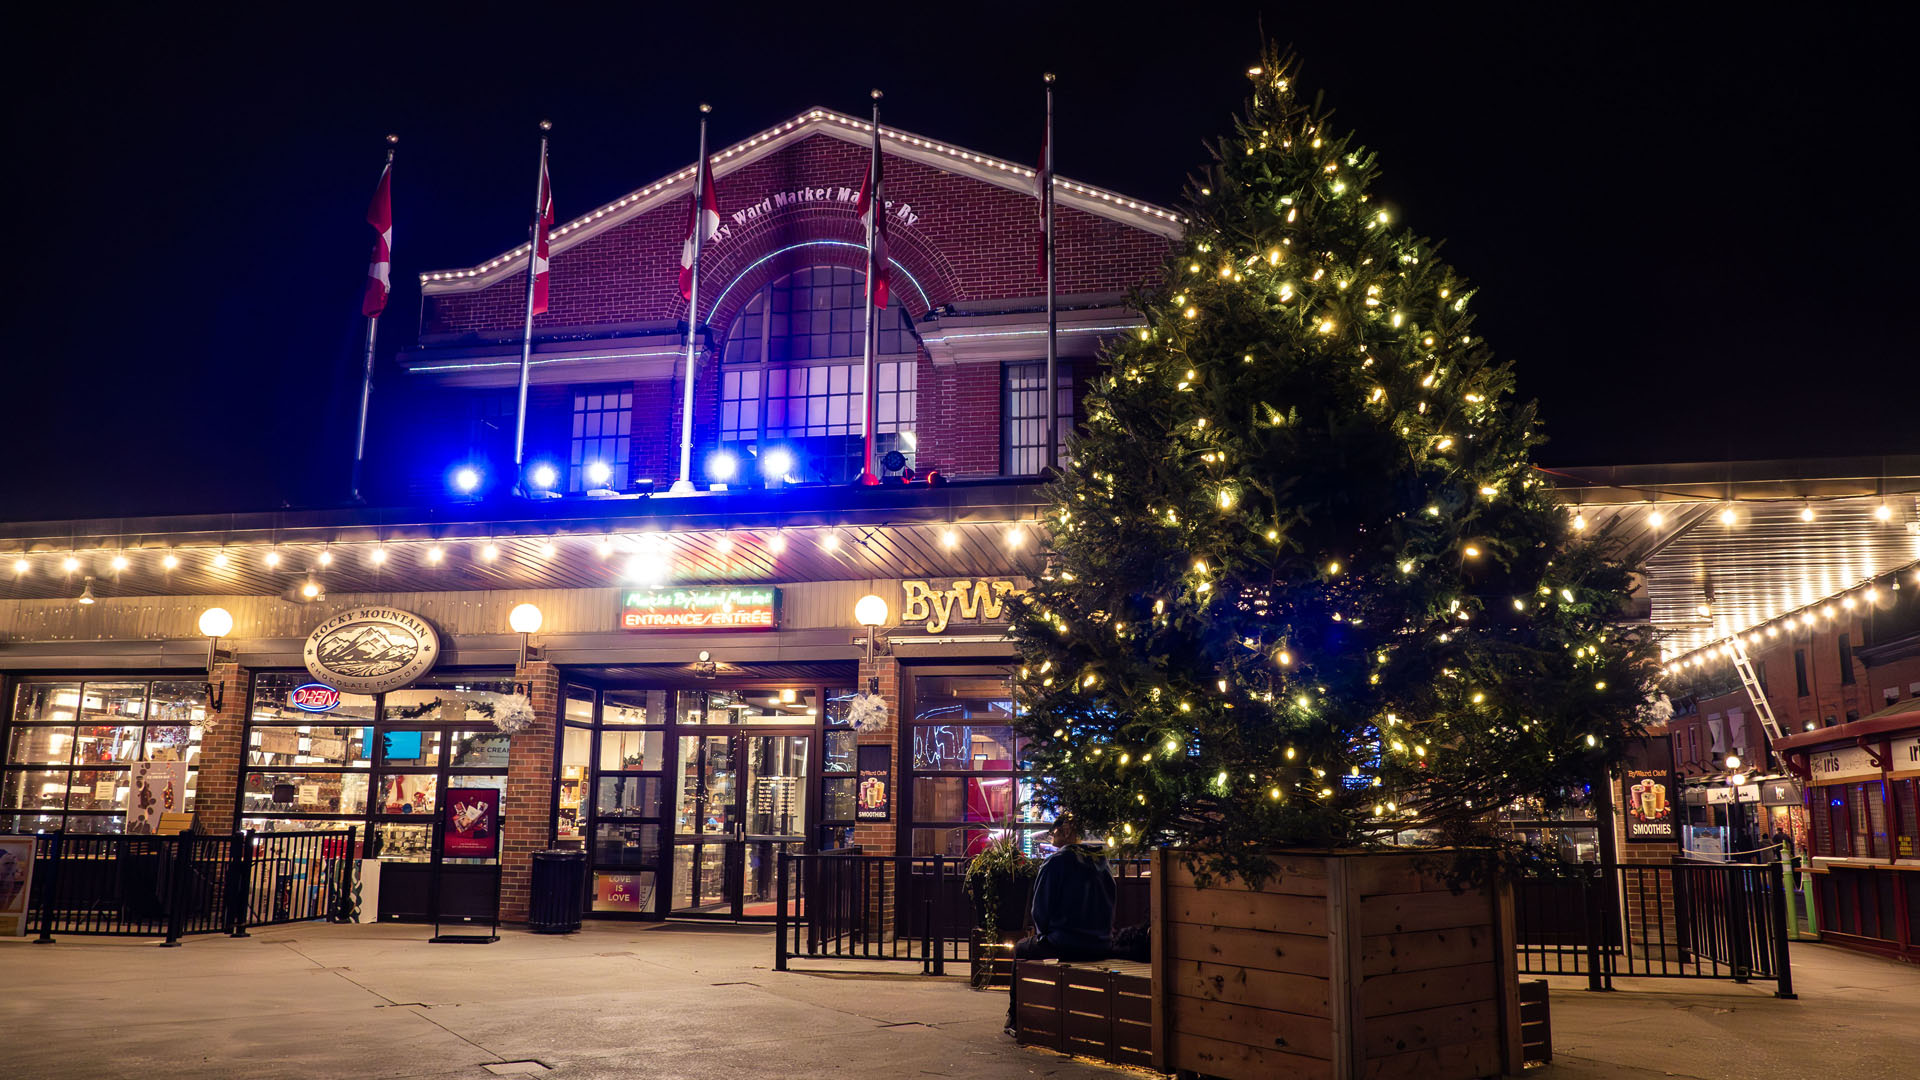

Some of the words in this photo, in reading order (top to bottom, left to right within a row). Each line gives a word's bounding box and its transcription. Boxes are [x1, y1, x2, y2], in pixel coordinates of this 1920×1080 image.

[732, 197, 772, 226] Ward
[773, 186, 832, 208] Market
[838, 186, 895, 214] Maé
[897, 203, 919, 226] By
[311, 611, 355, 642] ROCKY
[359, 609, 428, 639] MOUNTAIN
[310, 662, 369, 688] CHOCOLATE
[376, 660, 423, 687] FACTORY
[293, 689, 339, 706] OPEN
[1823, 752, 1840, 772] iris
[1628, 770, 1652, 778] ByWard
[1632, 824, 1671, 835] SMOOTHIES
[609, 875, 631, 883] LOVE
[615, 884, 623, 892] IS
[608, 894, 630, 902] LOVE
